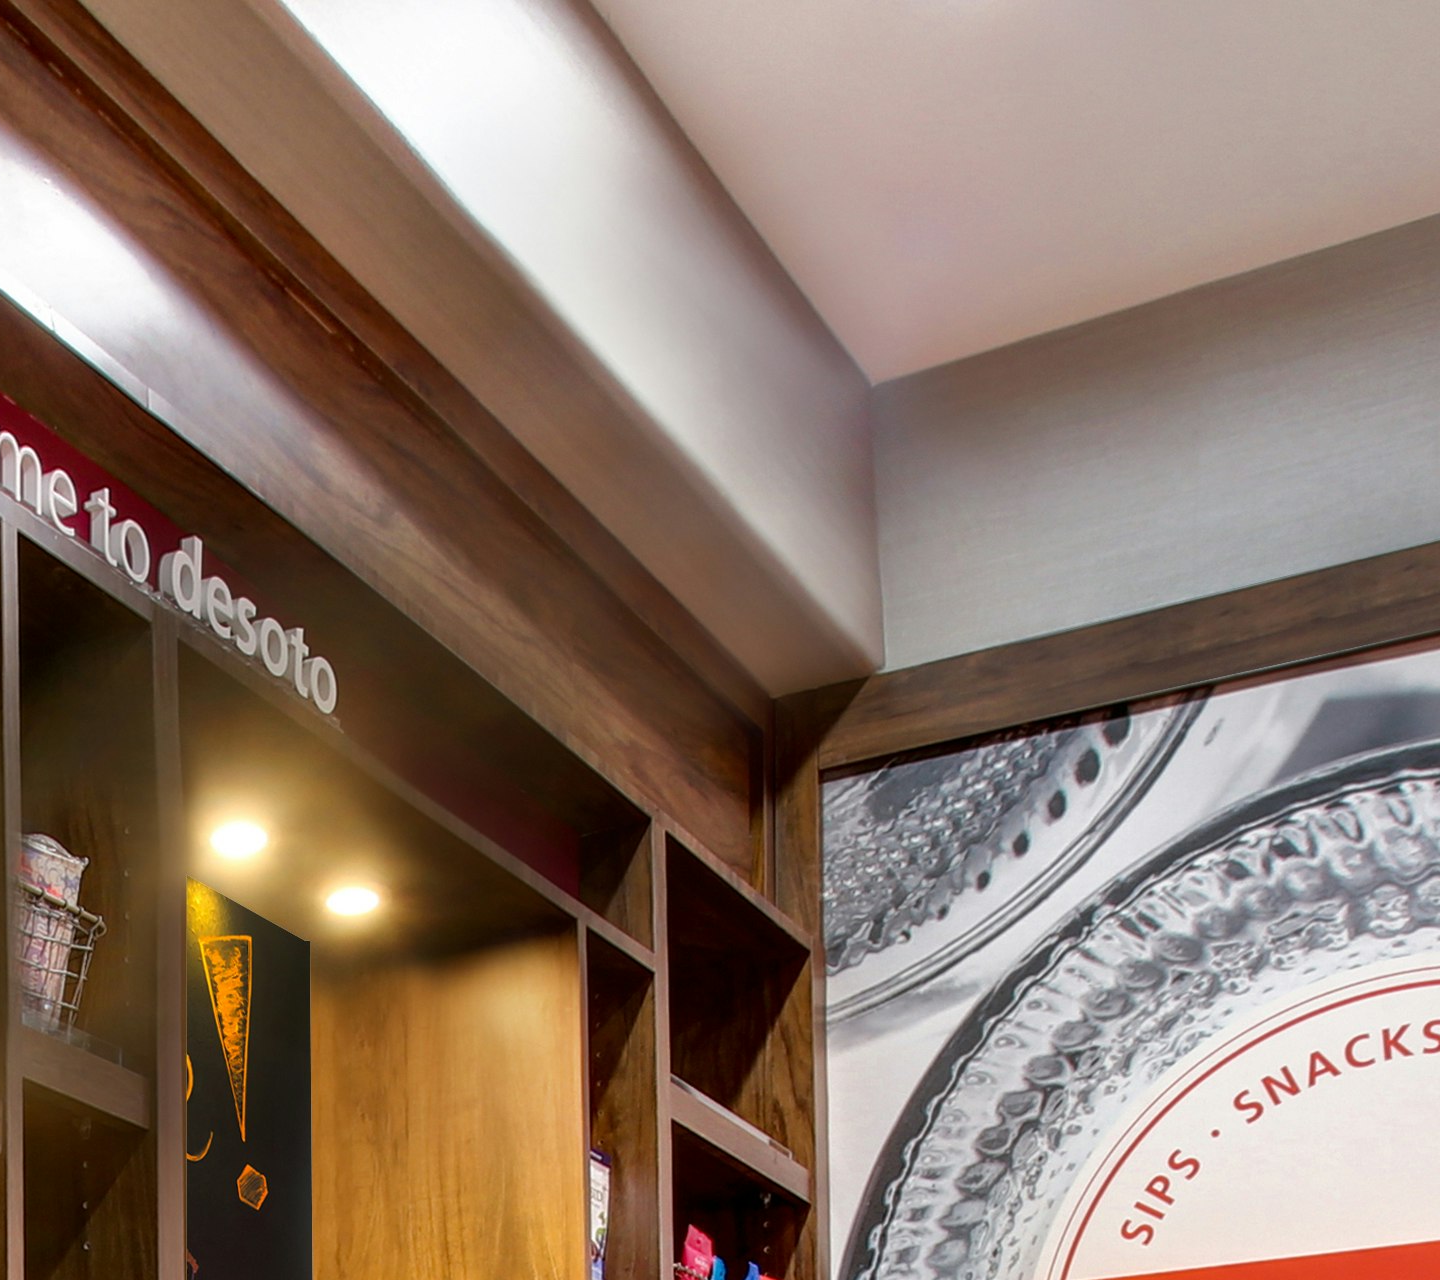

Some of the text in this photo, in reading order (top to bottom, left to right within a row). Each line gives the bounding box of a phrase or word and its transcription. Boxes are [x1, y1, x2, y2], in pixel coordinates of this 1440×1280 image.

[85, 487, 150, 584] to
[160, 535, 337, 715] desoto
[1121, 1147, 1202, 1246] SIPS
